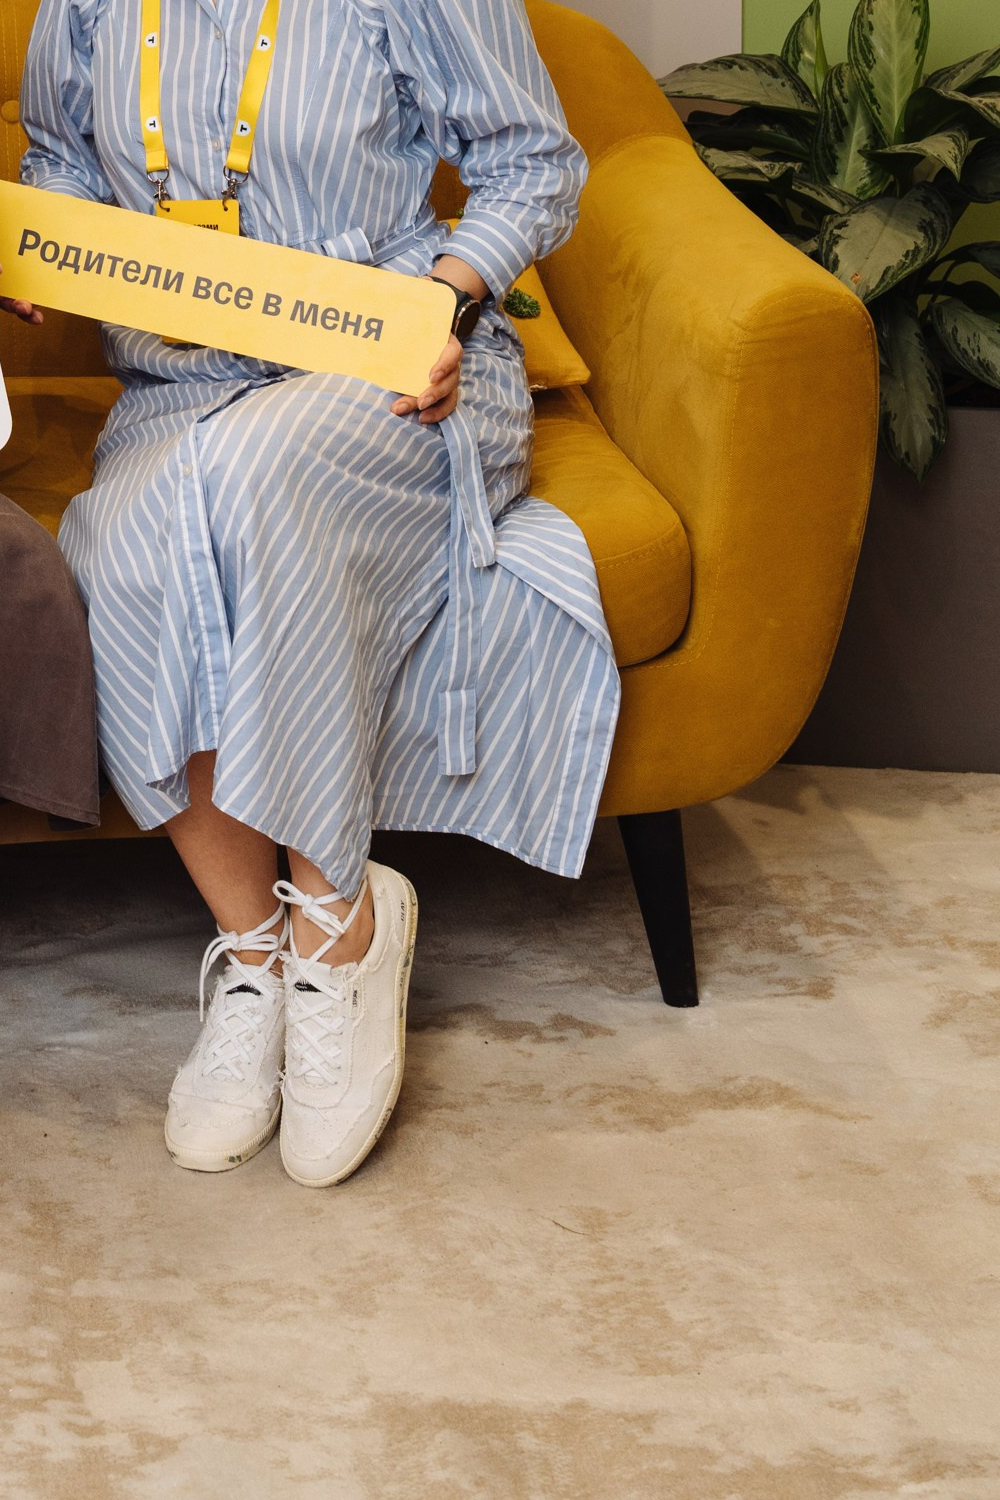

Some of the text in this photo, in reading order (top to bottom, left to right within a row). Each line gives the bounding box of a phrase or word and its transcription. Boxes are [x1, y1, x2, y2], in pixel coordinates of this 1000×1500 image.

[17, 228, 384, 342] Родители все в меня
